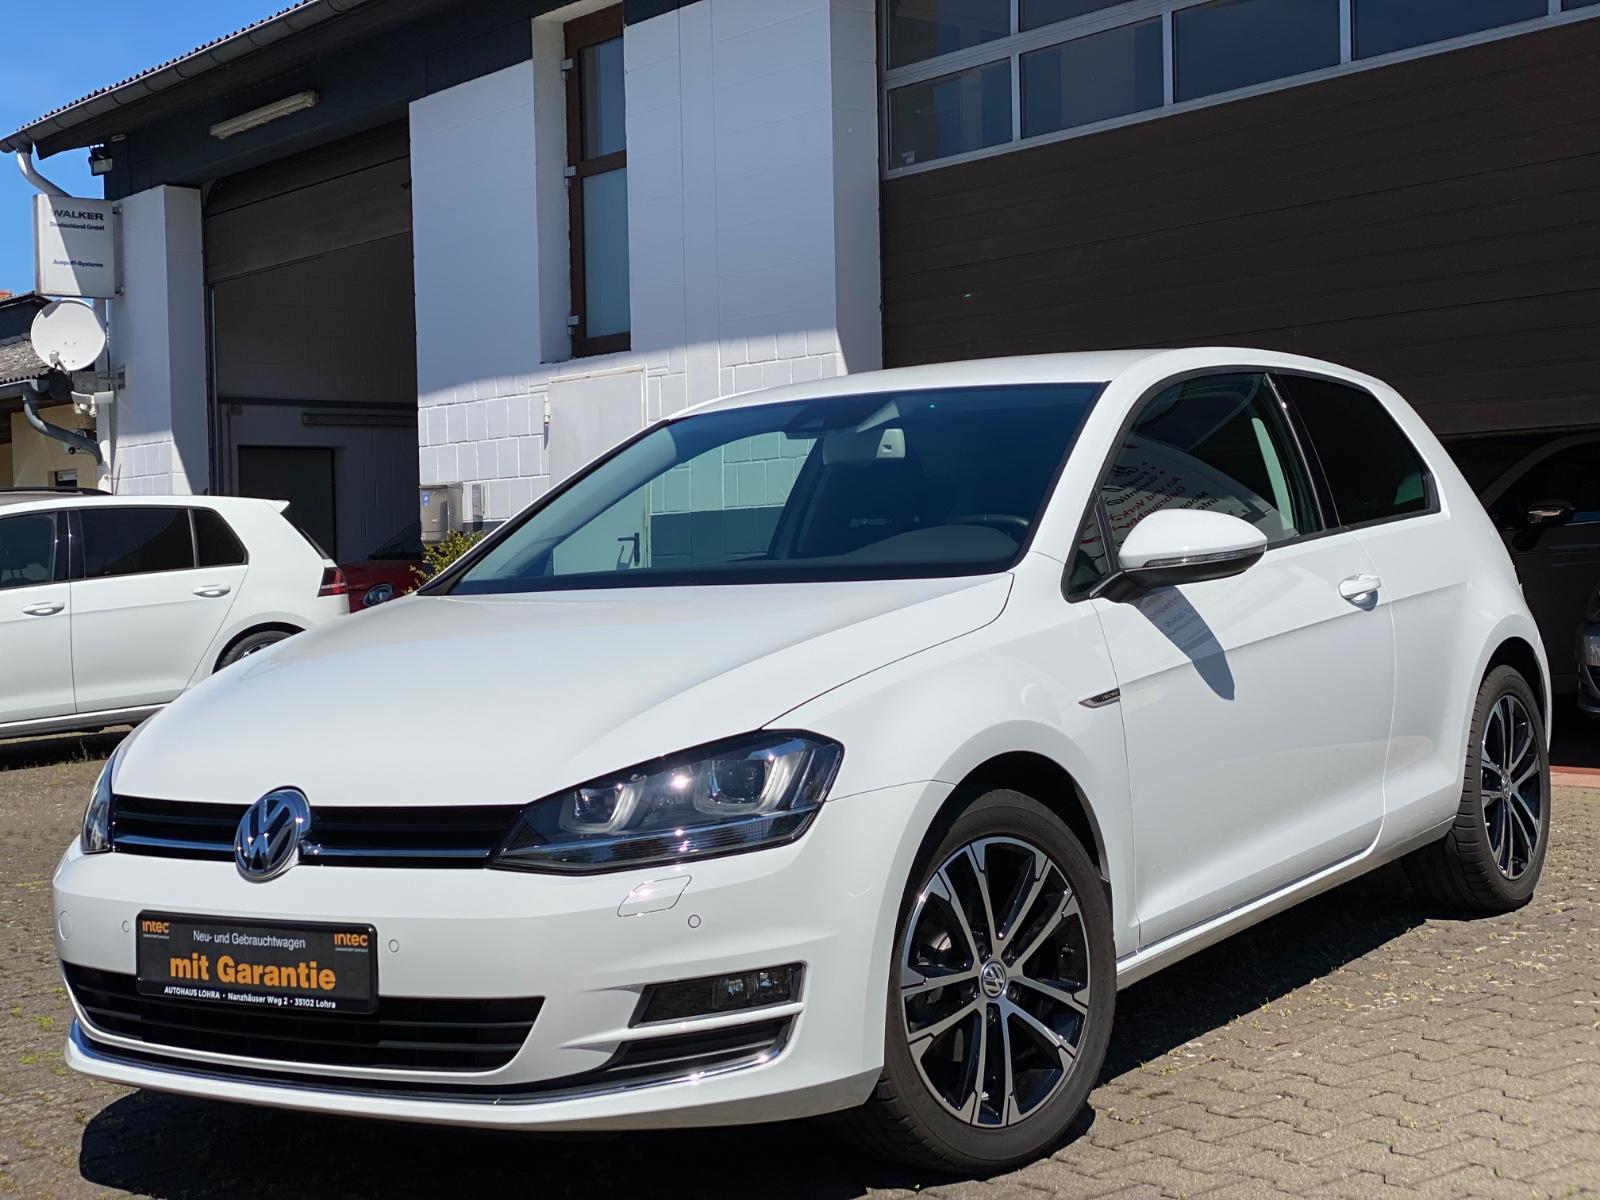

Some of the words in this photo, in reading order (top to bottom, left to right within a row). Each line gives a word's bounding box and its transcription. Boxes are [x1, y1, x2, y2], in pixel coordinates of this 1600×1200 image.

[51, 208, 104, 221] WALKER
[86, 223, 105, 231] GmbH
[142, 920, 169, 933] intec
[192, 930, 212, 942] Neu-
[214, 932, 230, 944] und
[231, 933, 306, 950] Gebrauchtwagen
[334, 933, 368, 947] intec
[170, 952, 209, 980] mit
[216, 955, 336, 990] Garantie
[164, 985, 198, 997] AUTOHAUS
[198, 988, 220, 999] LOHRA
[227, 992, 265, 1003] Nanzhäuser
[266, 995, 282, 1007] Weg
[283, 997, 288, 1005] 2
[294, 998, 314, 1007] 35102
[315, 1000, 336, 1009] Lohra
